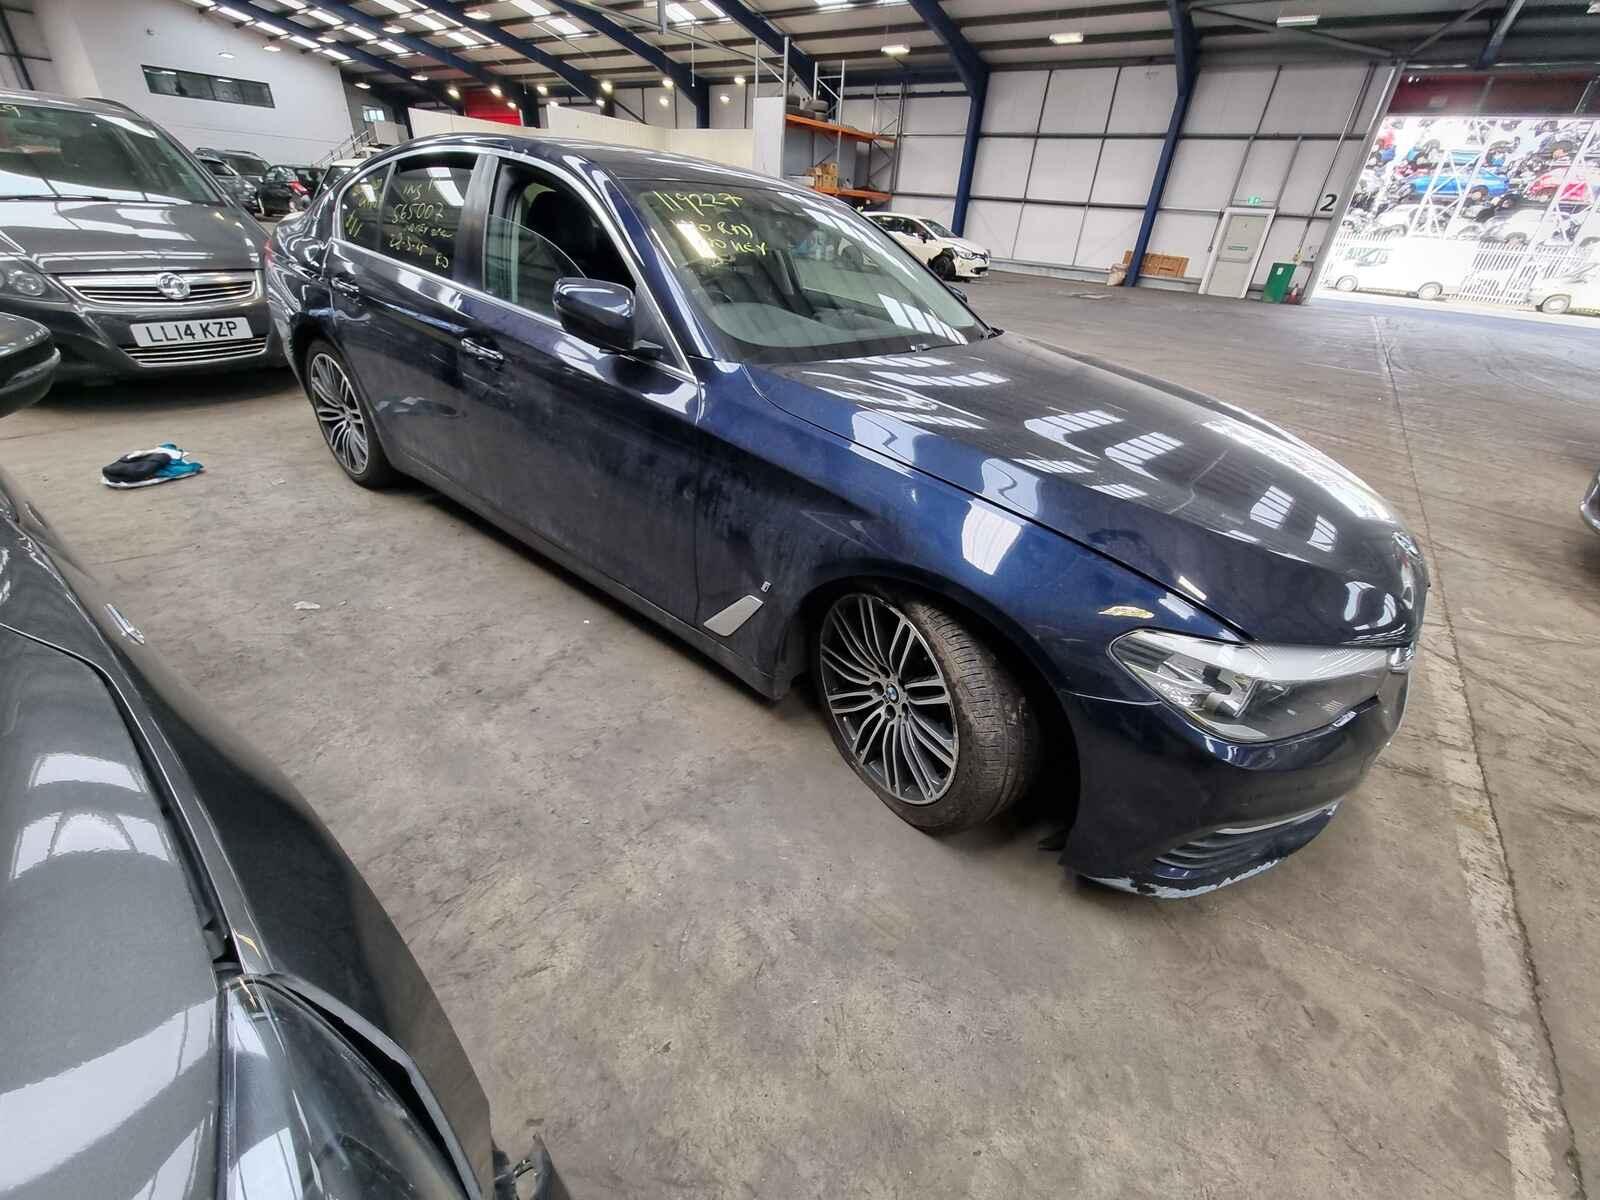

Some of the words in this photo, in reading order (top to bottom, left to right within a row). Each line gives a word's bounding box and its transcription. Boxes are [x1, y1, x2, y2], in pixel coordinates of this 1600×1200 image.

[1319, 193, 1338, 212] 2
[146, 323, 196, 342] LL14
[200, 321, 237, 339] KZP
